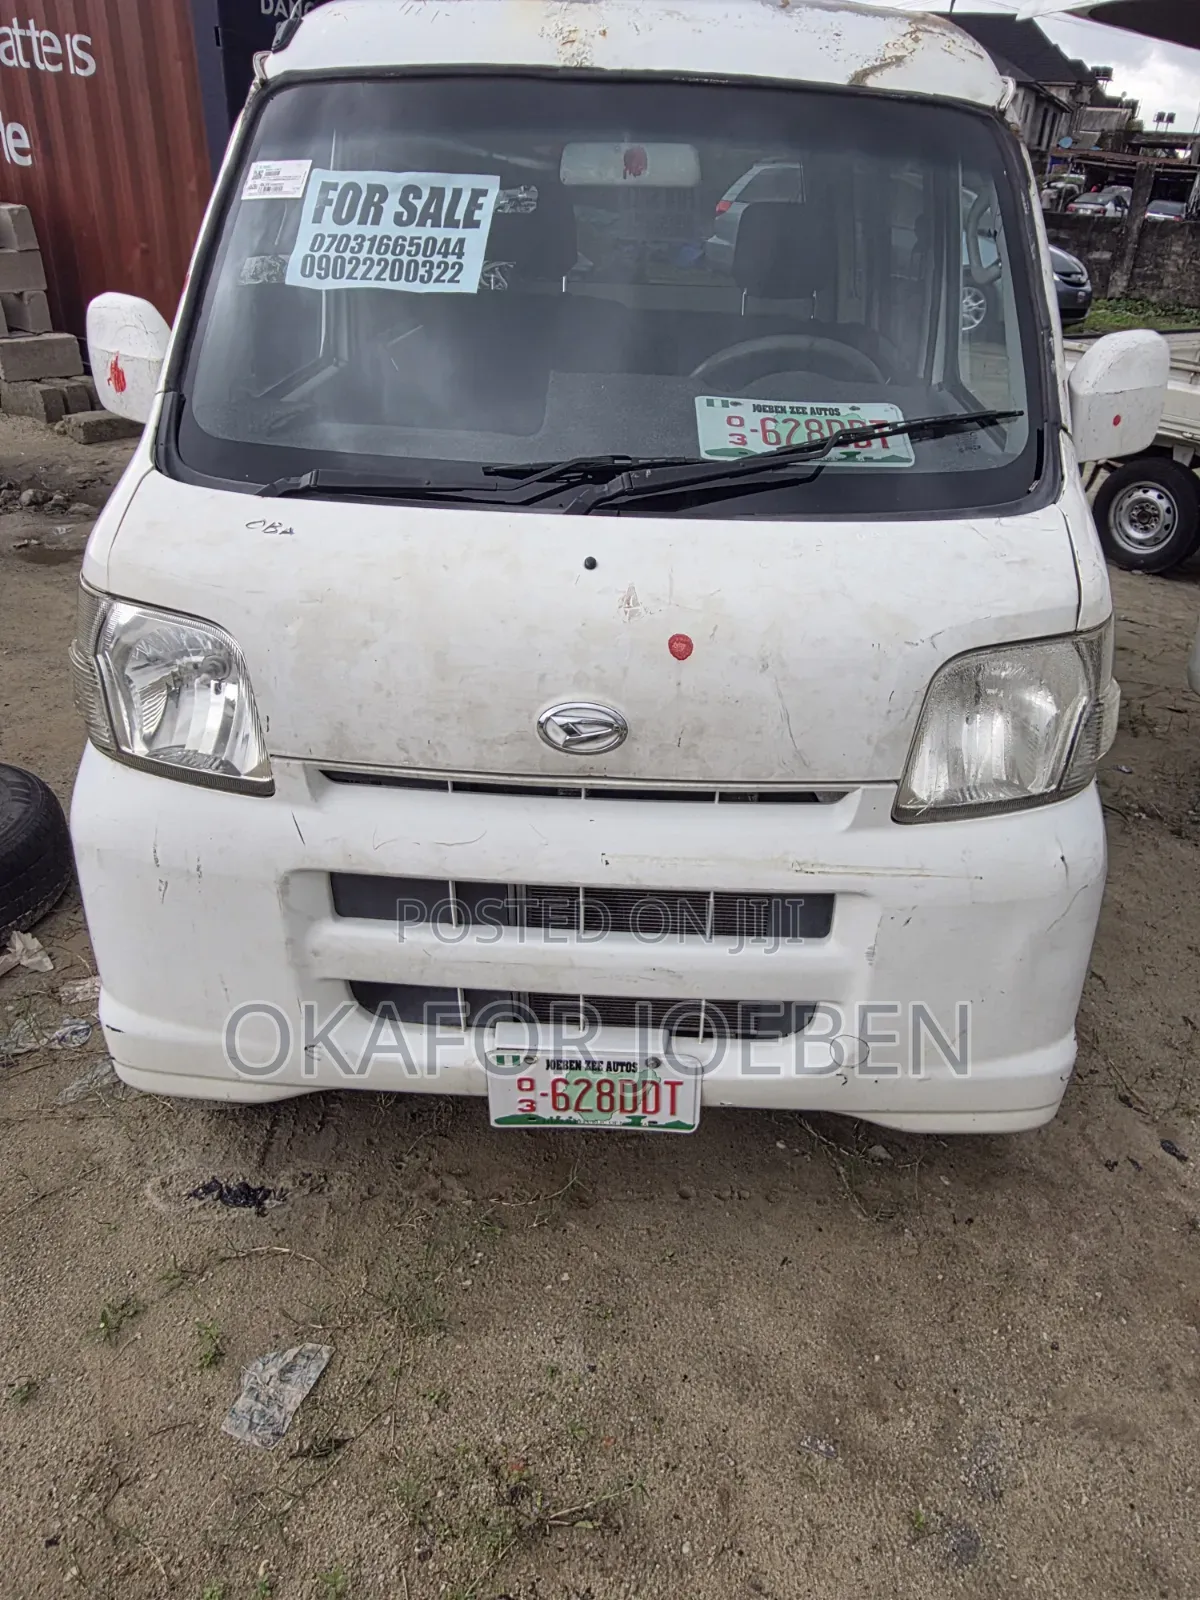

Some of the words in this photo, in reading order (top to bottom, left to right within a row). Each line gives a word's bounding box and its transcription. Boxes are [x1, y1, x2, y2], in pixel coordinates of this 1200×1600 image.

[311, 181, 389, 227] FOR
[393, 184, 488, 229] SALE
[309, 232, 466, 259] 07031665044
[300, 254, 464, 284] 09022200322
[752, 403, 787, 414] JOEBEN
[789, 406, 808, 415] ZEE
[810, 407, 841, 417] AUTOS
[545, 1058, 581, 1071] JOEBEN
[585, 1060, 604, 1072] ZEE
[606, 1060, 638, 1073] AUTOS
